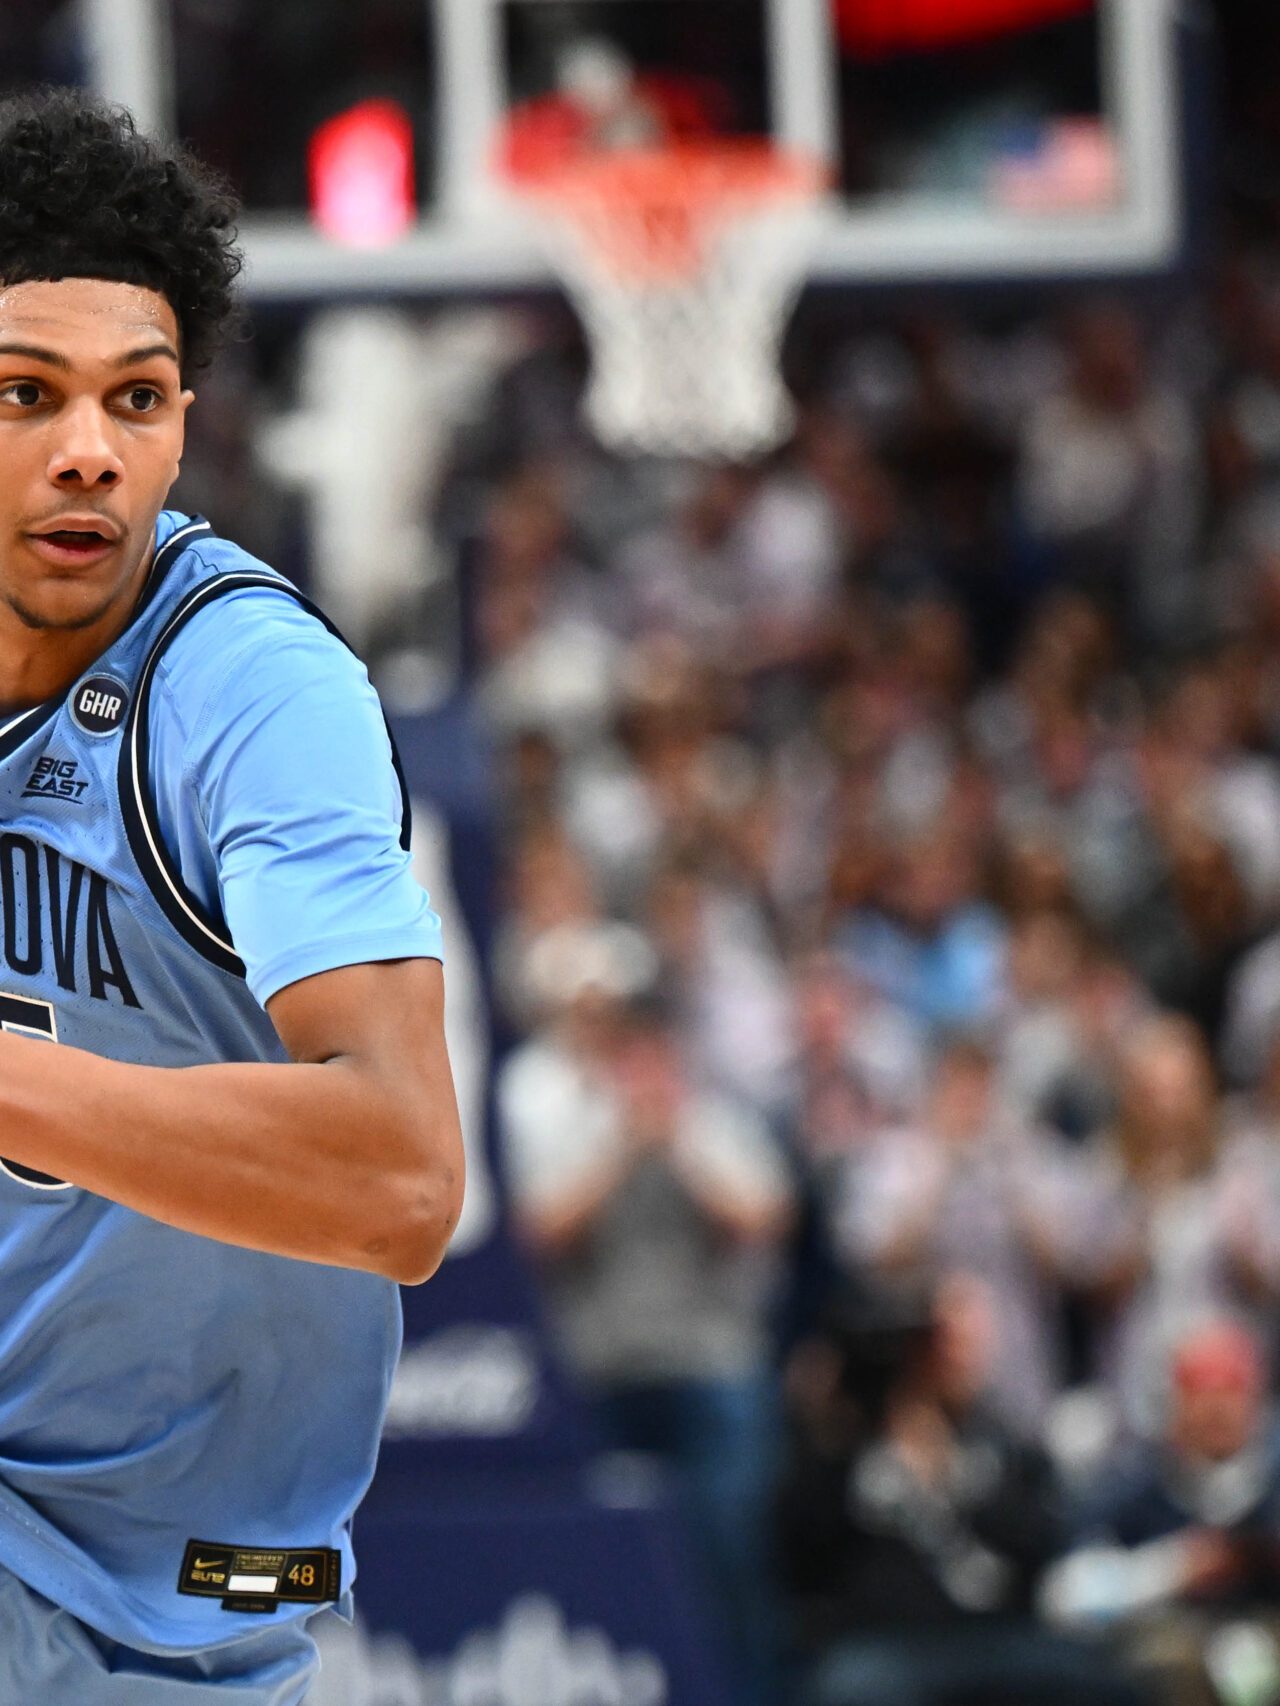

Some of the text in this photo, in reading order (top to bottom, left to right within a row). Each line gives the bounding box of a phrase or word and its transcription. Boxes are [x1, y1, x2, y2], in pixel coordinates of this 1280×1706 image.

[78, 688, 122, 720] GHR
[33, 756, 79, 779] BIG
[25, 772, 89, 798] EAST
[287, 1563, 316, 1587] 48
